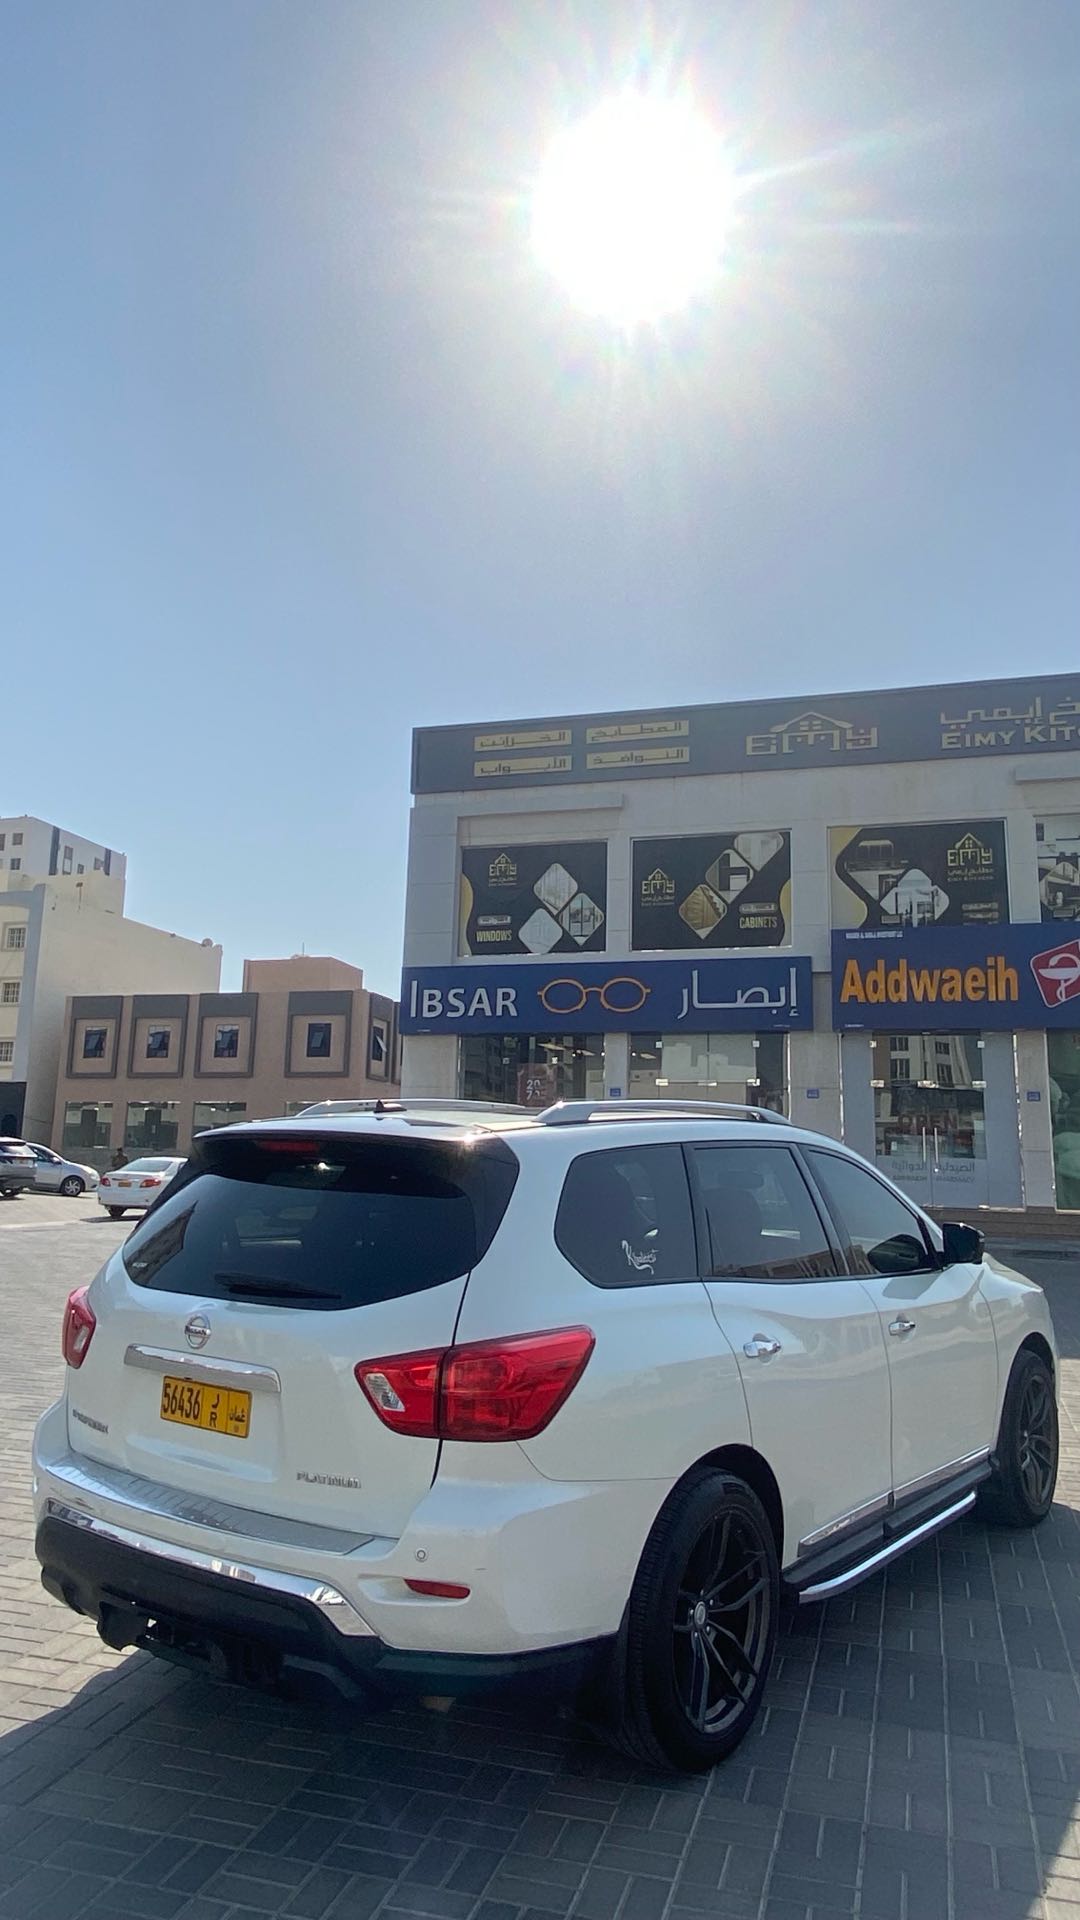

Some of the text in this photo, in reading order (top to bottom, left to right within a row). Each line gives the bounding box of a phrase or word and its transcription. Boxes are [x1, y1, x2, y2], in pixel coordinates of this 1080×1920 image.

[476, 929, 513, 943] WINDOWS
[739, 916, 778, 930] CABINETS
[677, 967, 799, 1019] إبصار
[840, 956, 1019, 1003] Addwaeih
[410, 980, 518, 1018] IBSAR
[162, 1382, 201, 1421] 56436
[209, 1411, 218, 1428] R
